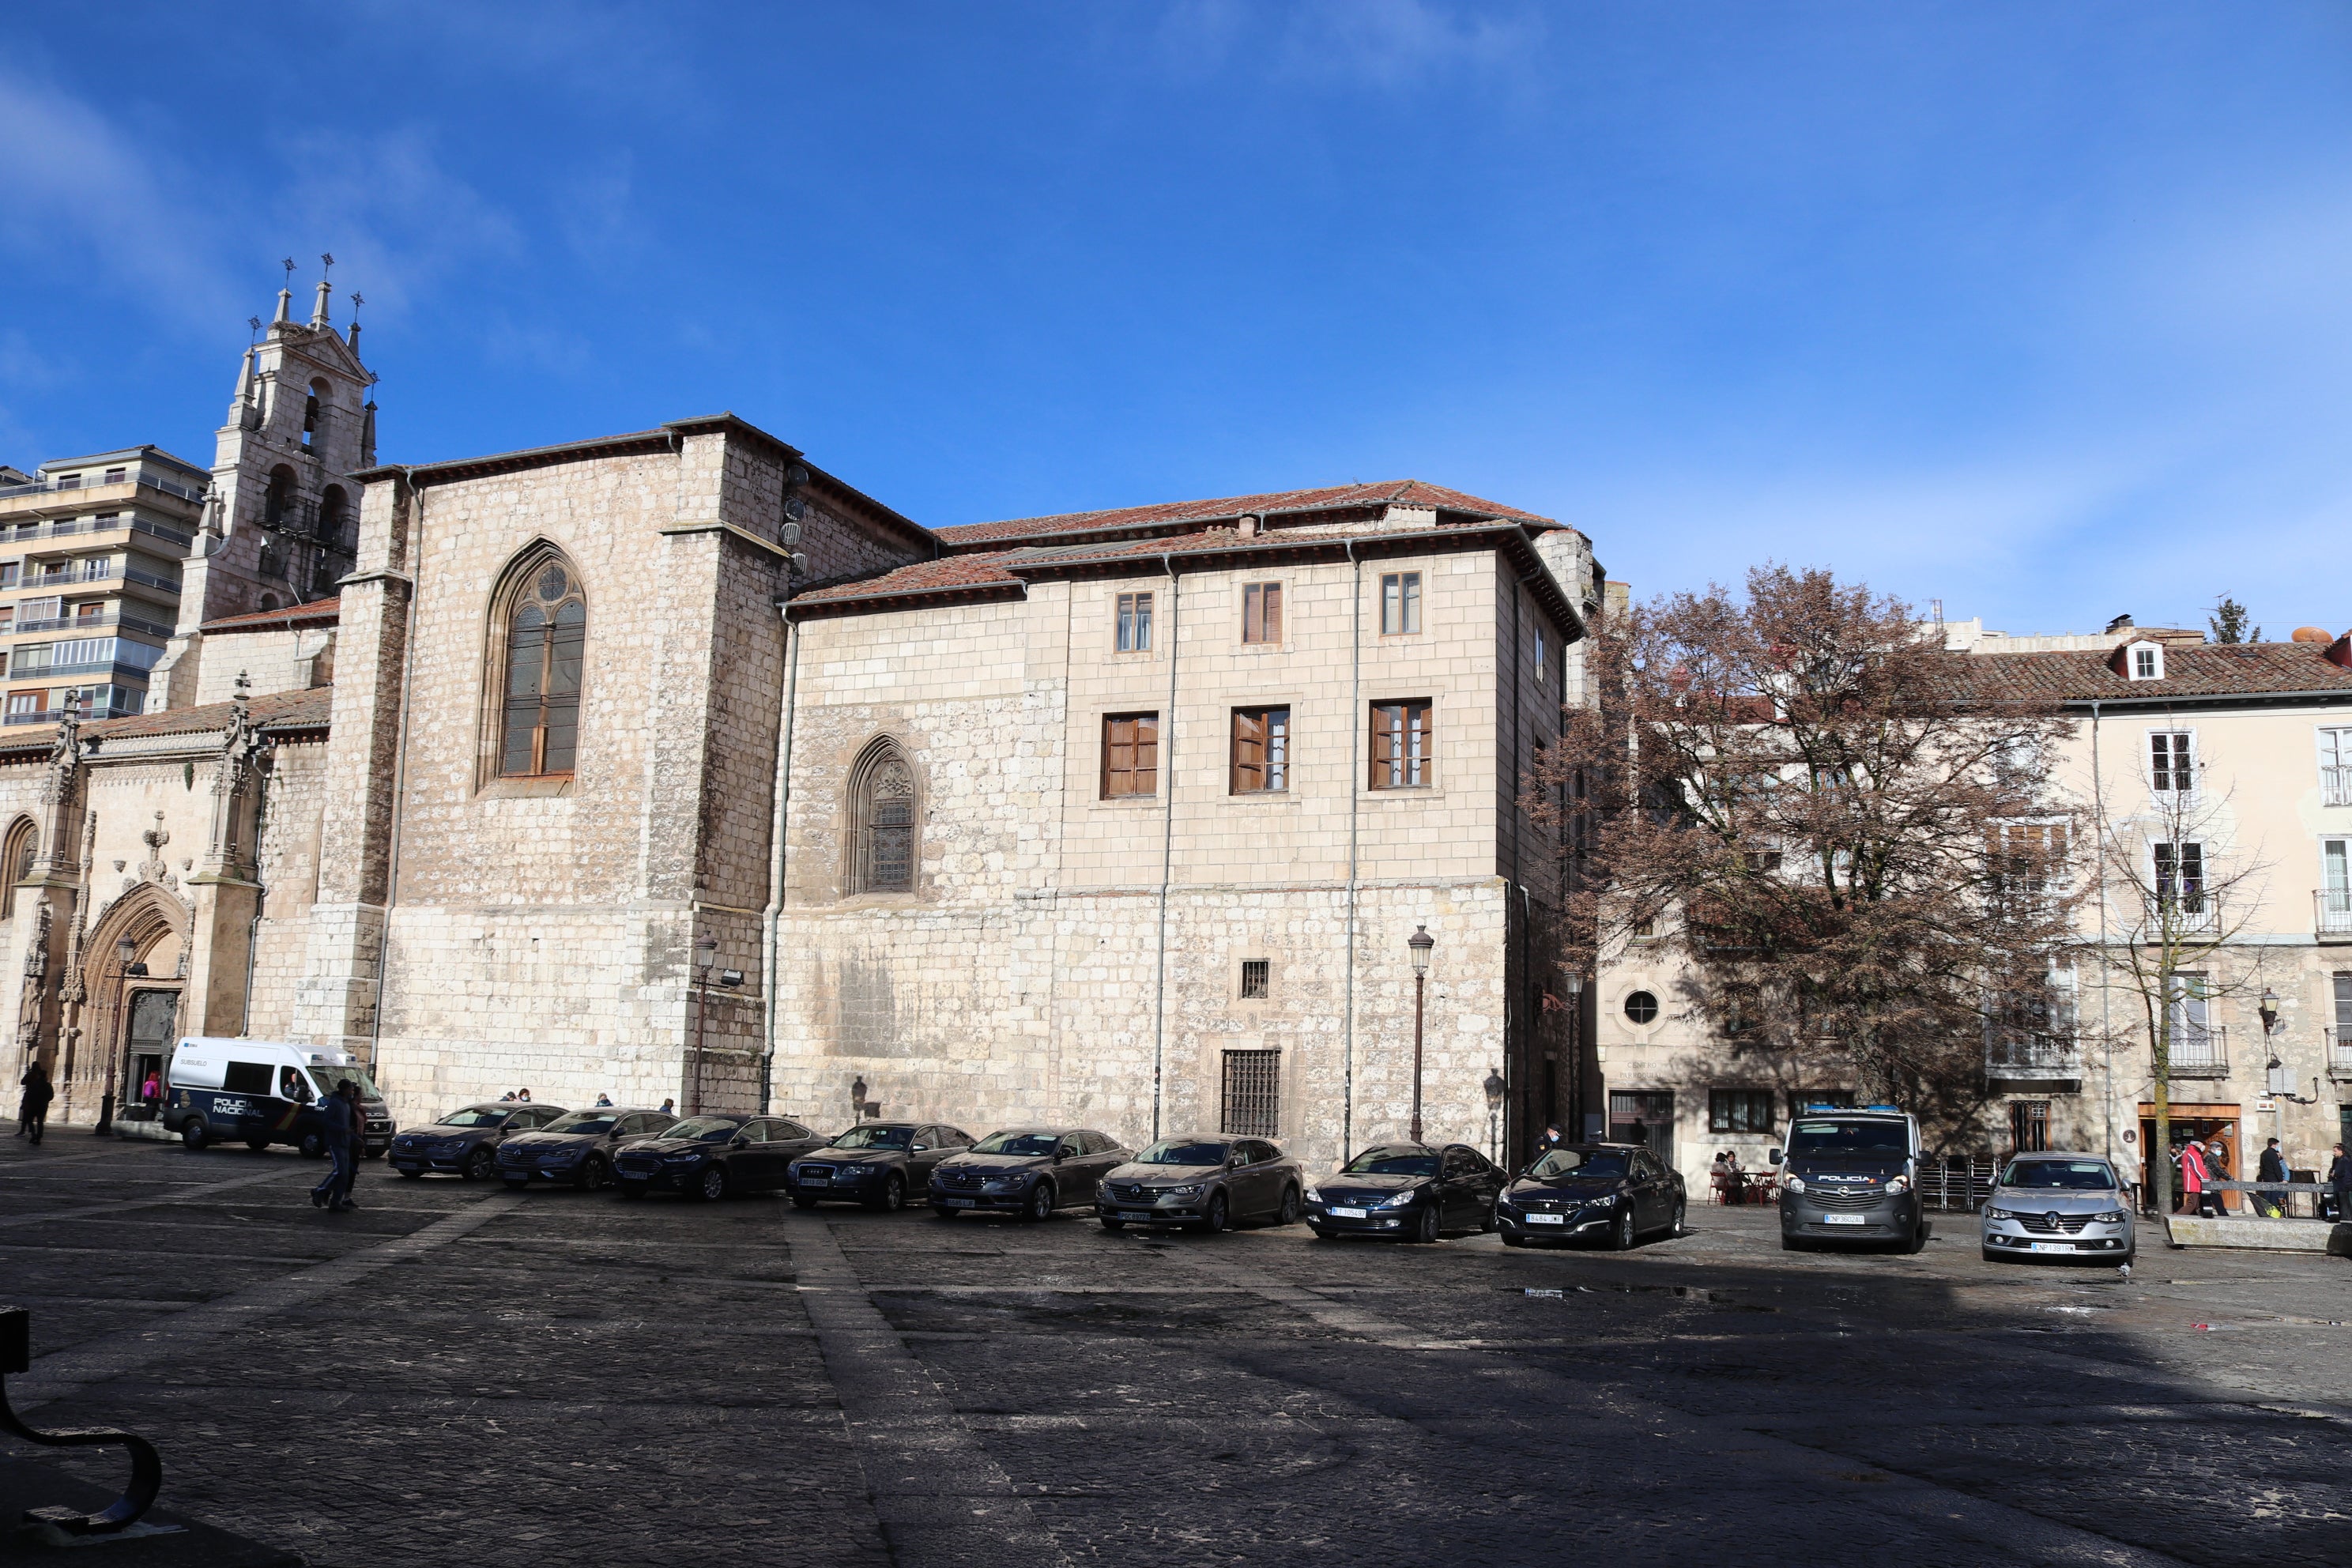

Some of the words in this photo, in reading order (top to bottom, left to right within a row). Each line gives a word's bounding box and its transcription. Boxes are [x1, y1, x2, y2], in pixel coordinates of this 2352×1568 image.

[180, 1058, 207, 1067] SUBSUELO
[214, 1097, 253, 1108] POLICÍA
[213, 1105, 264, 1118] NACIONAL
